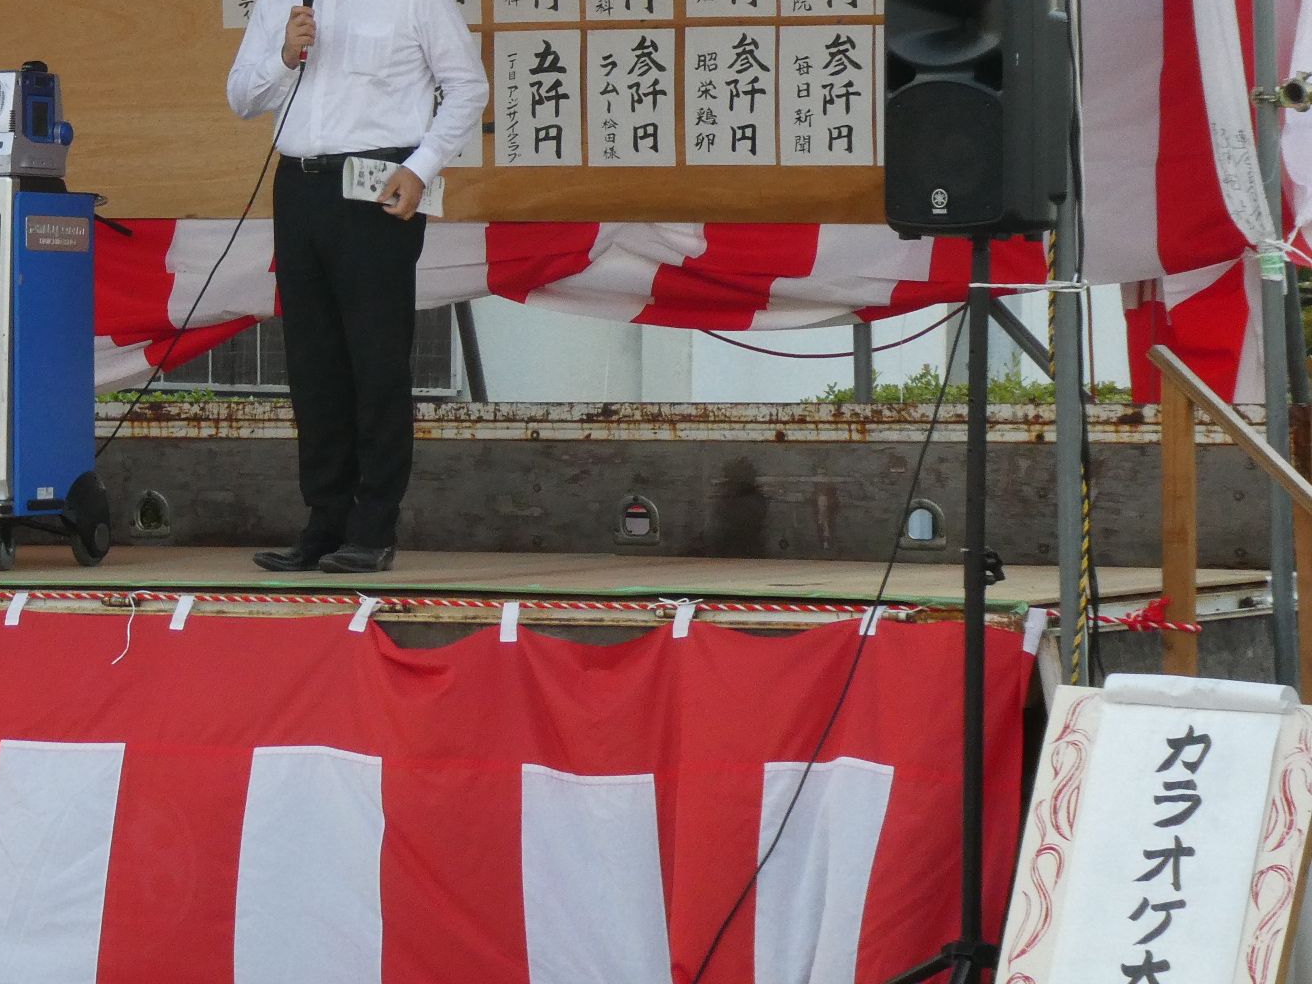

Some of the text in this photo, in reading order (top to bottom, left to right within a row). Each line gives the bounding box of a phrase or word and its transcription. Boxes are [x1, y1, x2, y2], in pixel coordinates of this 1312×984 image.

[694, 51, 719, 153] 昭栄鶏卵
[793, 55, 815, 155] 毎日新聞
